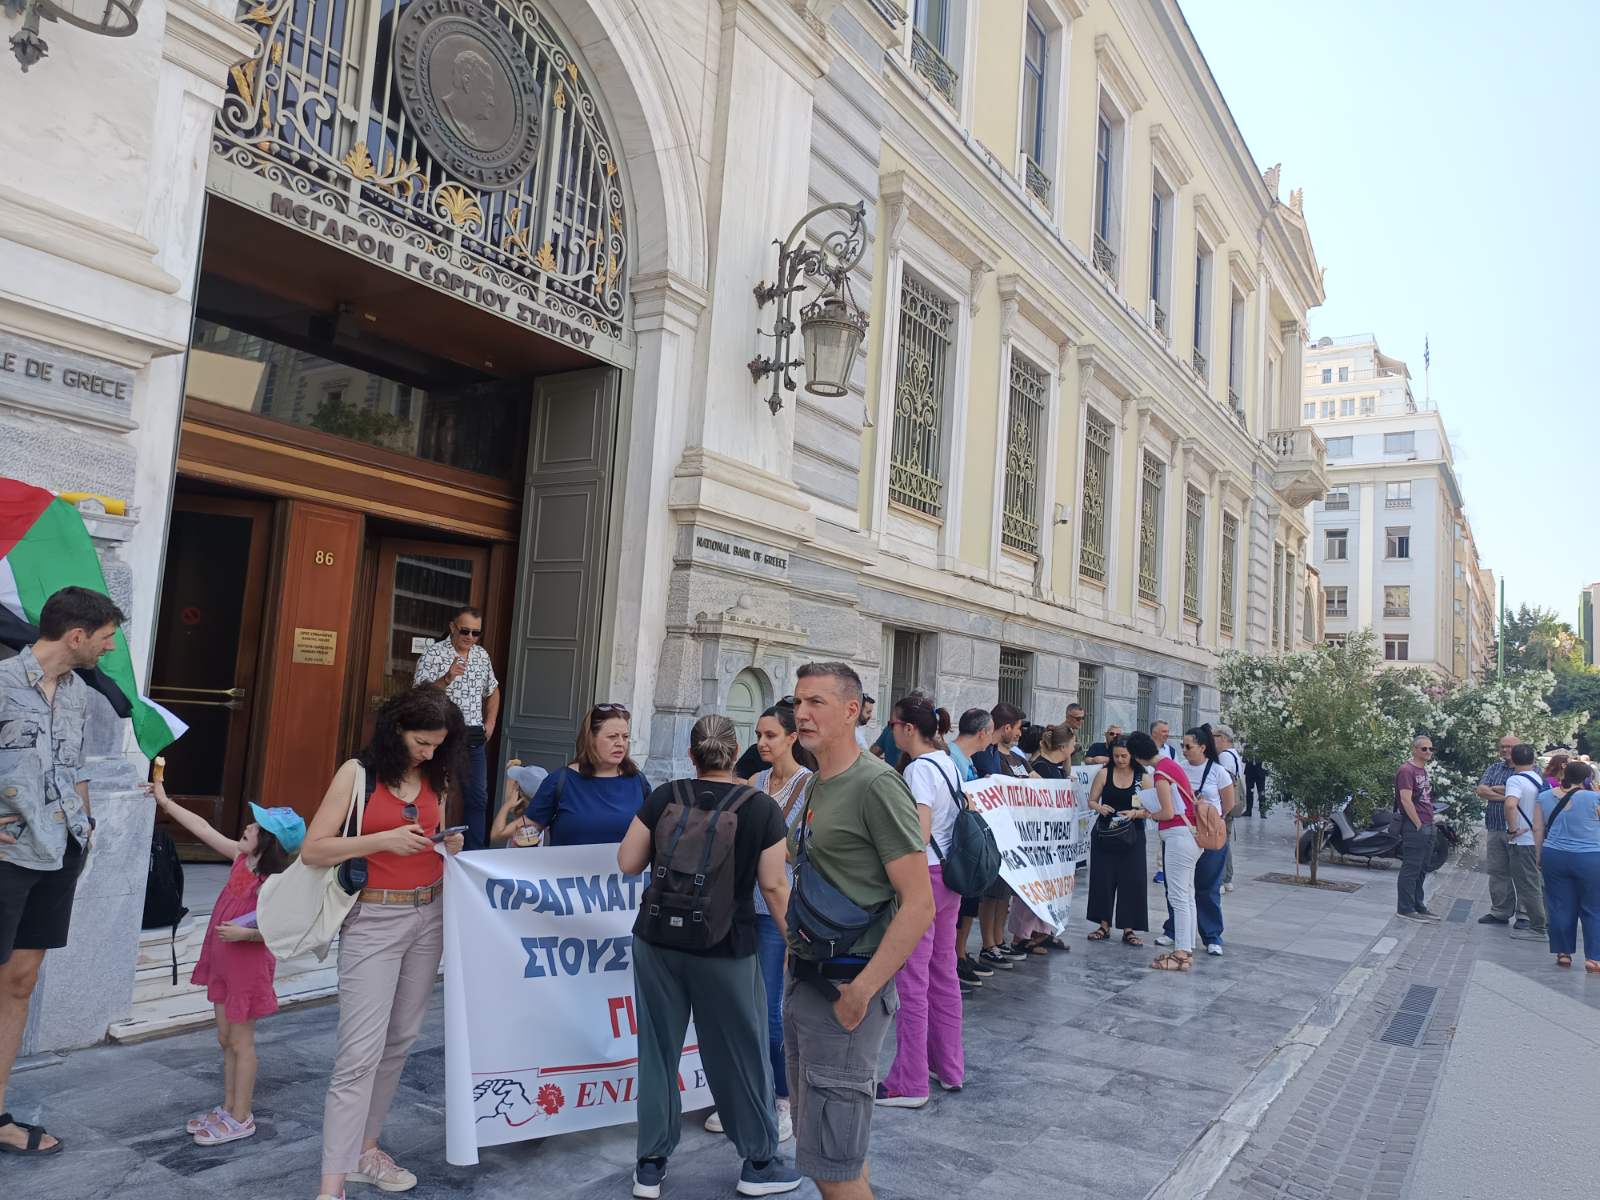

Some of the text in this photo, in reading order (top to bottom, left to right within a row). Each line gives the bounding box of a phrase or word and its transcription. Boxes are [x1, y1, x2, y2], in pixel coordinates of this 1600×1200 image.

[270, 191, 595, 349] ΜΕΓΑΡΟΝ ΓΕΩΡΓΙΟΥ ΣΤΑΥΡΟΥ
[25, 358, 54, 381] DE
[315, 550, 334, 565] 86
[696, 536, 787, 569] NATIONAL BANK OF GREECE
[520, 935, 633, 979] ΣΤΟΥΣ
